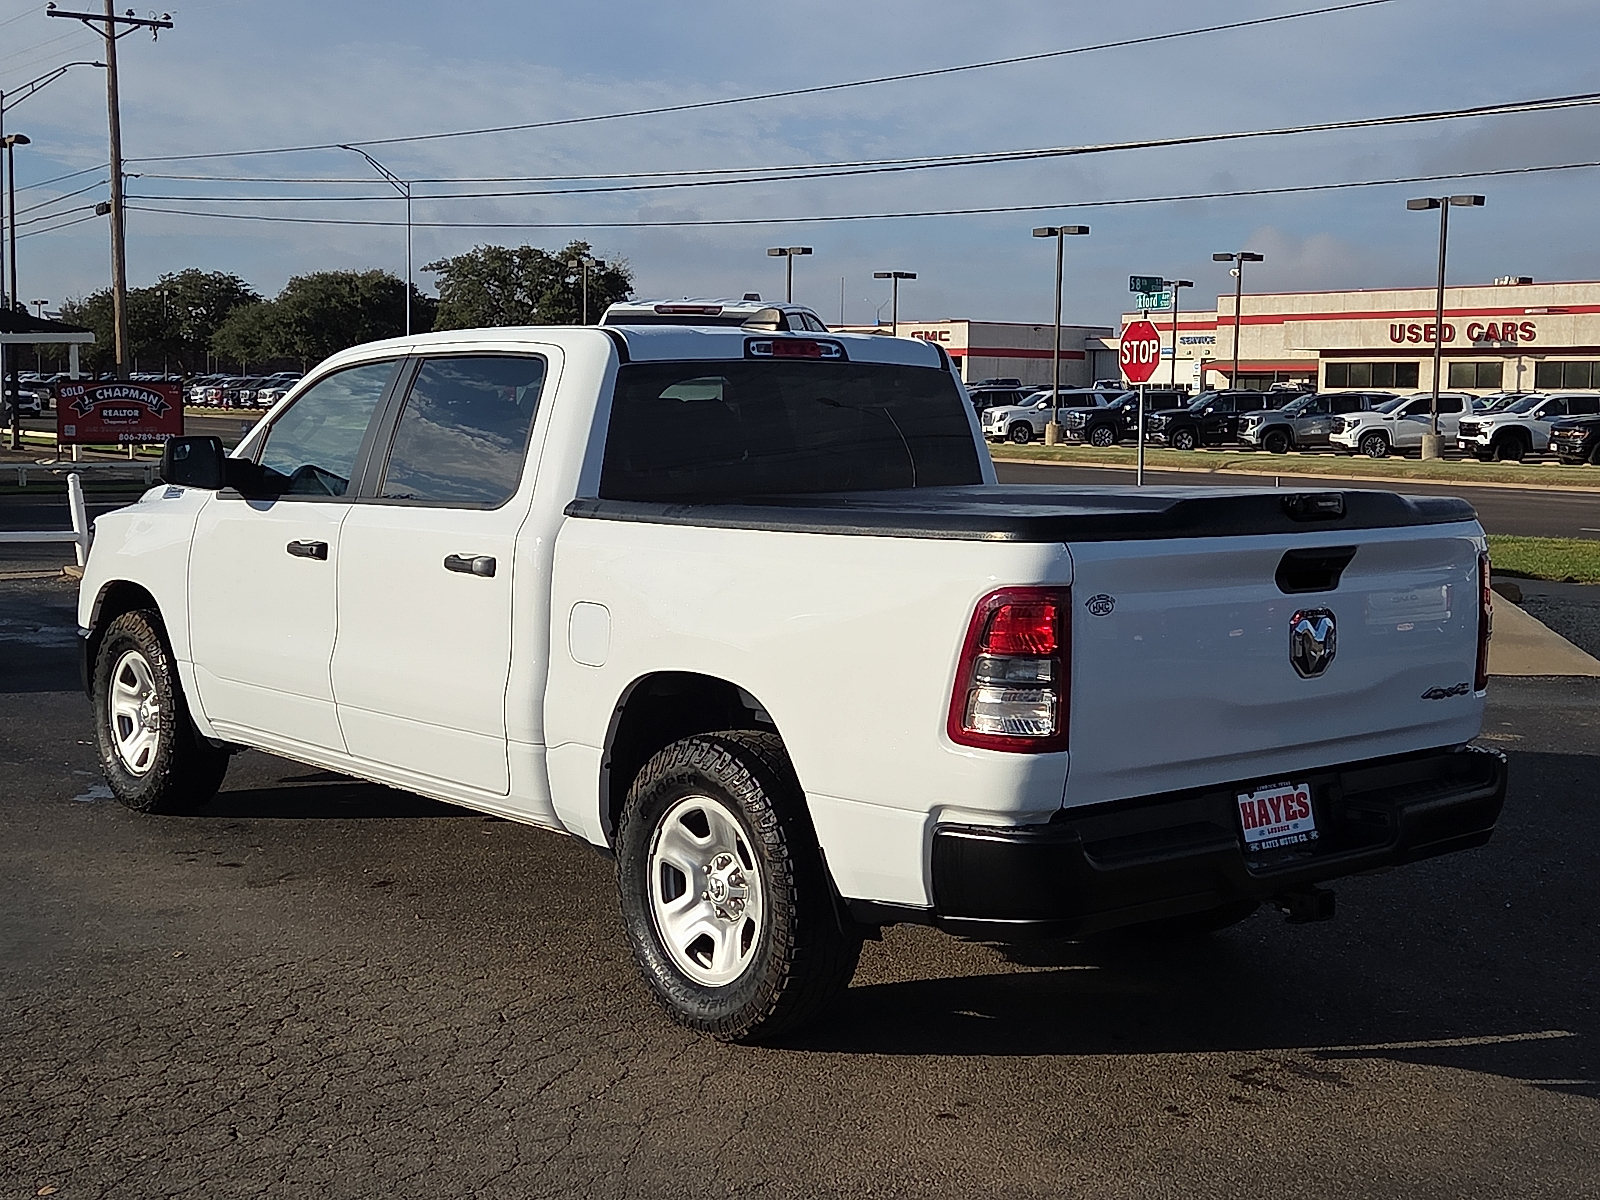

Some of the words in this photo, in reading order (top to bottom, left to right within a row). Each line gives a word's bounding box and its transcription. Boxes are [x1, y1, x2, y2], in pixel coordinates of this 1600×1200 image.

[910, 330, 951, 342] GMC
[1389, 323, 1457, 343] USED
[1466, 321, 1537, 342] CARS
[1179, 336, 1217, 344] SERVICE
[1121, 339, 1159, 364] STOP
[60, 385, 85, 398] SOLD
[95, 387, 159, 405] CHAPMAN
[102, 409, 140, 417] REALTOR
[1240, 791, 1310, 830] HAYES
